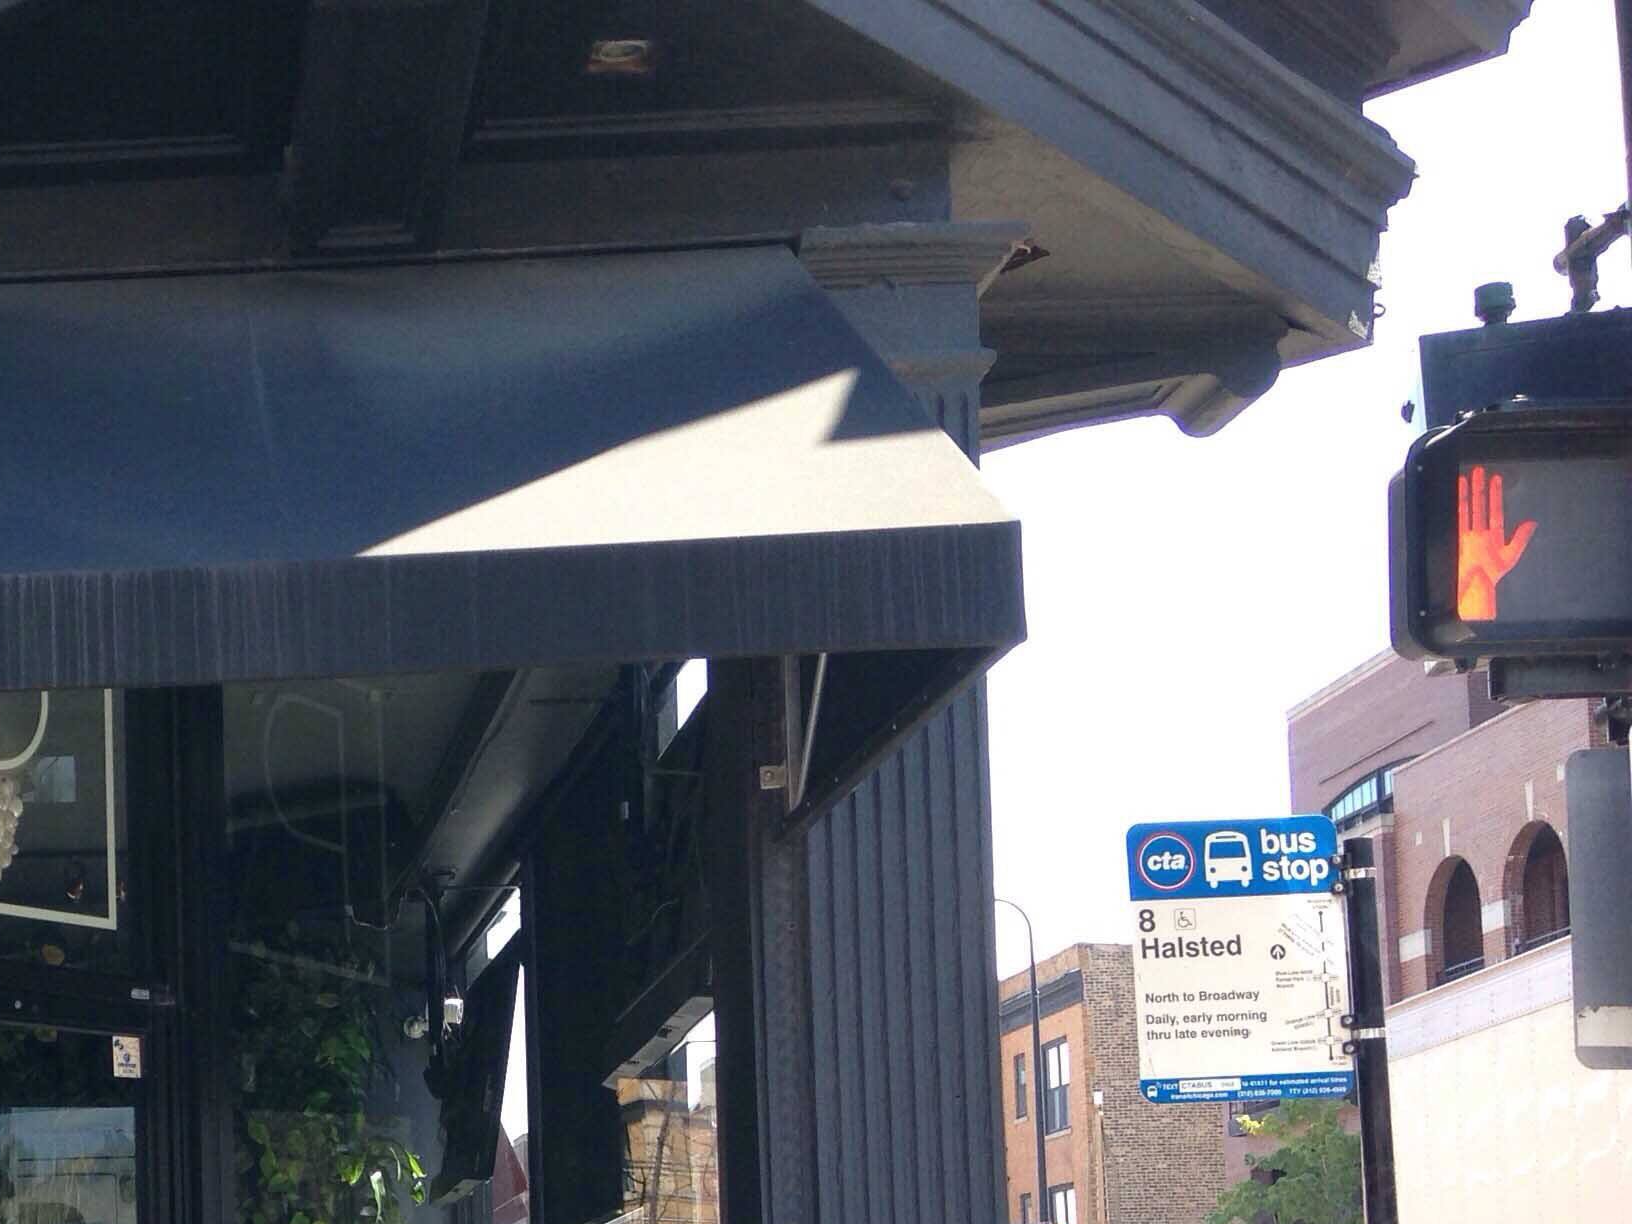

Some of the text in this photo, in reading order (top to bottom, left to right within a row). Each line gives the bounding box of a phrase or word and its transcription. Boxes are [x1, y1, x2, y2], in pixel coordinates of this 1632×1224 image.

[1259, 828, 1316, 855] bus
[1147, 851, 1186, 872] cta
[1262, 857, 1329, 886] stop
[1138, 908, 1156, 933] 8
[1141, 934, 1243, 960] Halsted
[1145, 989, 1260, 1004] North to Broadway
[1145, 1010, 1268, 1026] Daily, early morning
[1147, 1026, 1250, 1040] thru late evening
